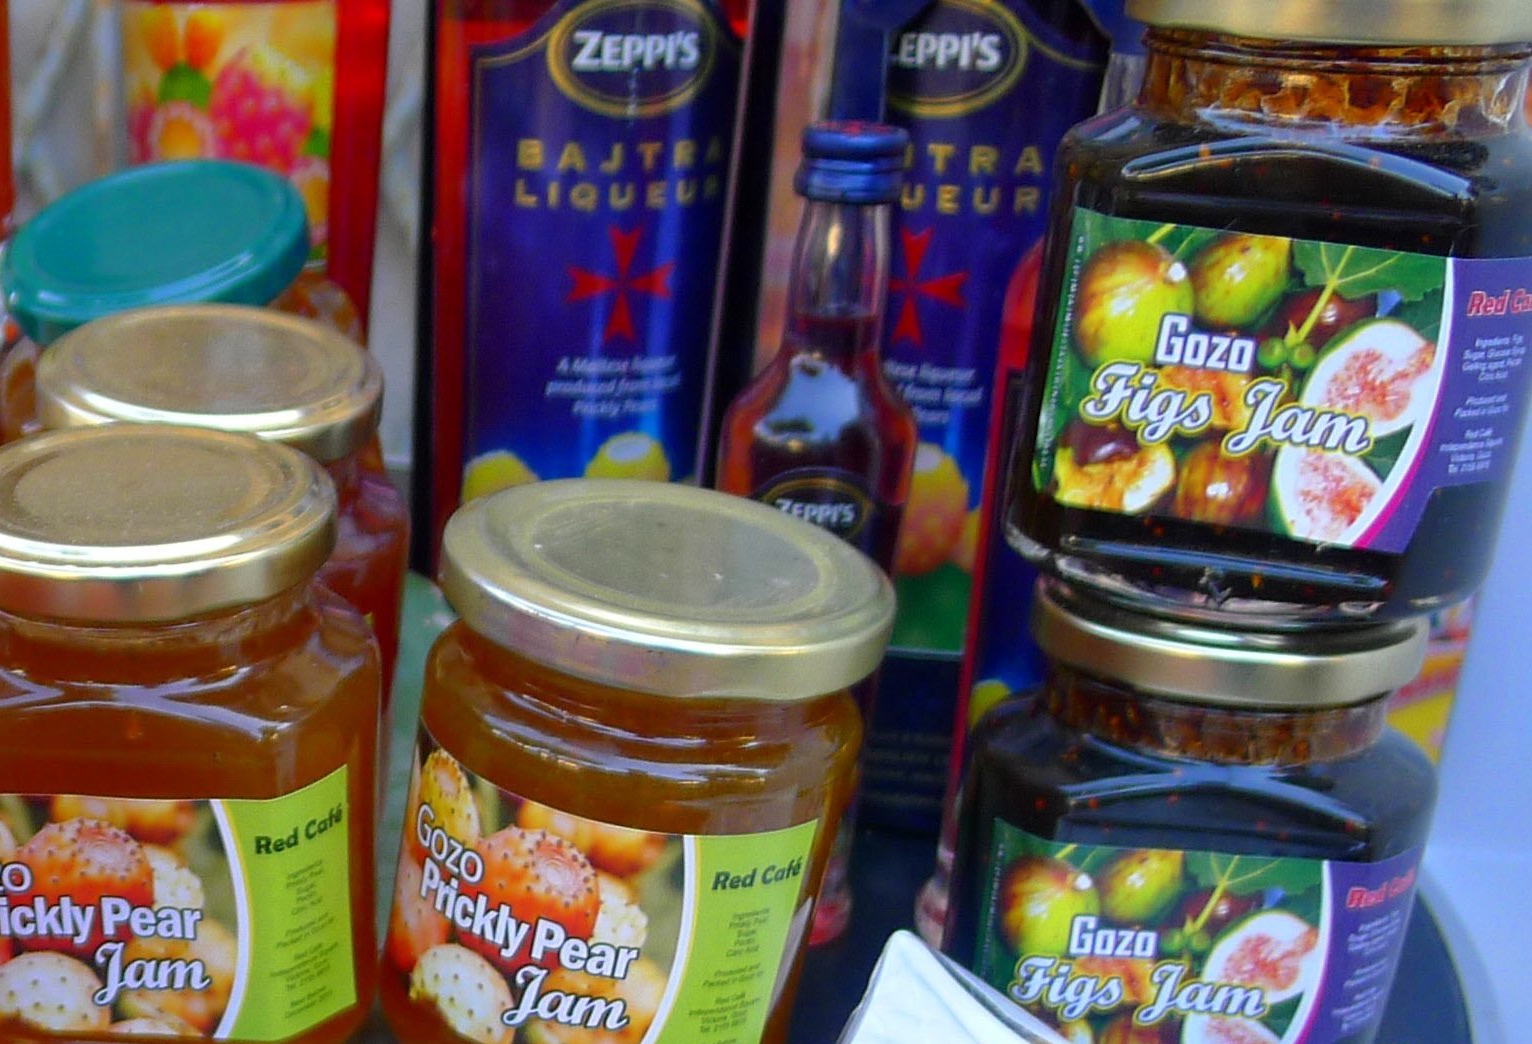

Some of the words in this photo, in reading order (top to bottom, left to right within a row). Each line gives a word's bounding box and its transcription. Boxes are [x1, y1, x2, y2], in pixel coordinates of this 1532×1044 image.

[573, 30, 700, 72] ZEPPI'S
[889, 31, 1003, 71] EPPI'S
[518, 137, 721, 174] BAJTRA
[514, 177, 719, 212] LIQUEUR
[900, 183, 1042, 215] UEUR
[1466, 289, 1511, 316] Red
[1082, 361, 1214, 446] Figs
[1225, 380, 1373, 453] Jam
[255, 826, 299, 855] Red
[304, 802, 343, 840] Café
[711, 866, 758, 891] Red
[760, 855, 803, 885] Café
[99, 896, 204, 941] Pear
[420, 857, 530, 959] Prickly
[531, 917, 640, 980] Pear
[93, 941, 212, 1006] Jam
[1011, 956, 1124, 1021] Figs
[1135, 962, 1268, 1024] Jam
[502, 965, 629, 1031] Jam
